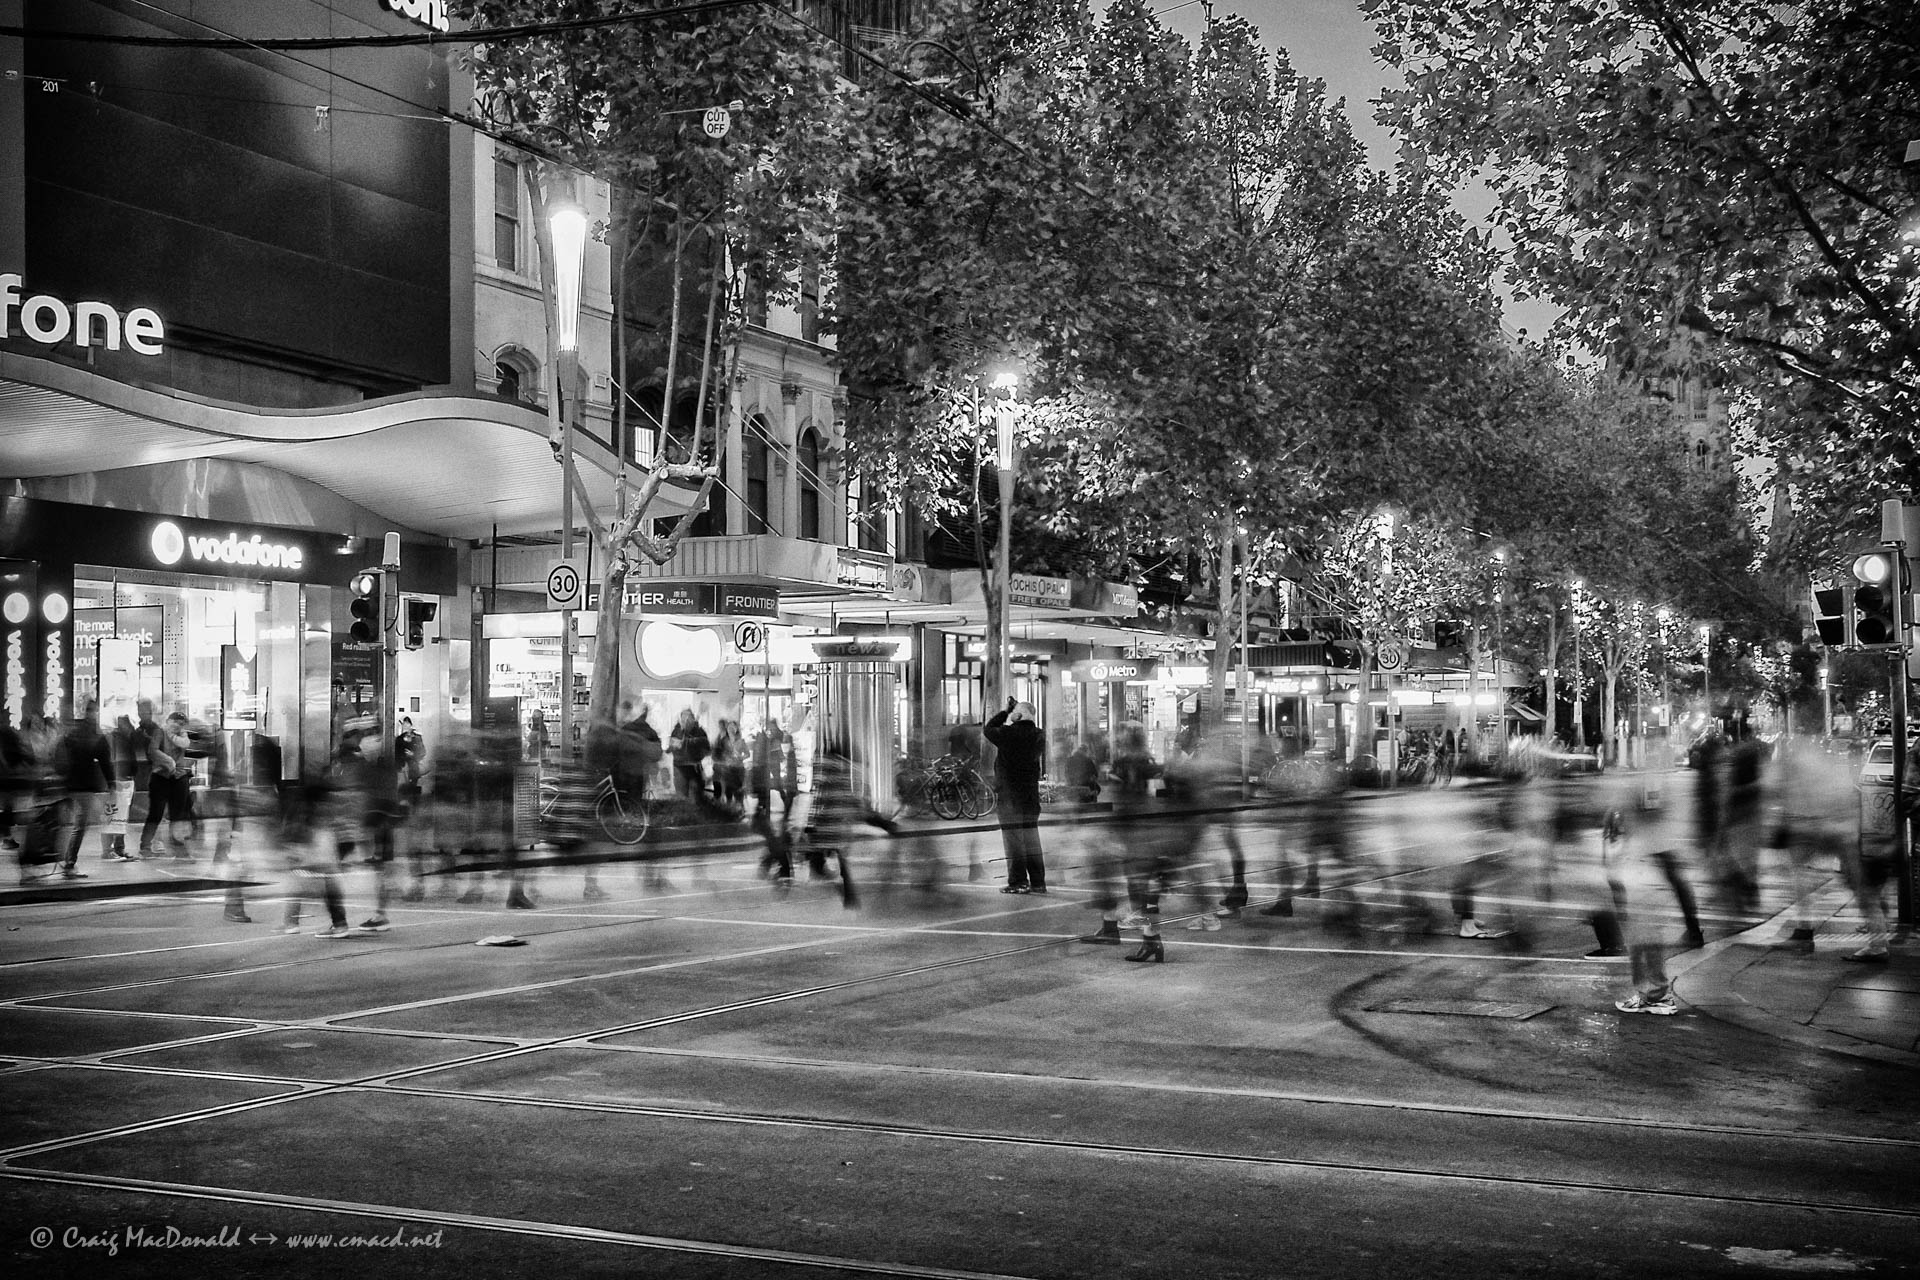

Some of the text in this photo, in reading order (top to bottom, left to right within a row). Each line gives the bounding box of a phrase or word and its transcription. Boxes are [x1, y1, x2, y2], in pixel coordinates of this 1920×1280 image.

[42, 81, 59, 92] 201
[707, 111, 726, 122] CUT
[707, 123, 725, 133] OFF
[0, 273, 165, 355] fone
[188, 533, 302, 569] vodafone
[552, 575, 575, 593] 30
[588, 592, 665, 606] FNTIER
[726, 596, 775, 610] FRONTIER
[1011, 595, 1070, 607] FREE OPALS
[75, 620, 115, 632] The more
[74, 627, 154, 650] meixels
[836, 643, 882, 653] news
[138, 655, 154, 665] ore
[46, 630, 64, 718] vodafo
[1109, 666, 1137, 677] Metro
